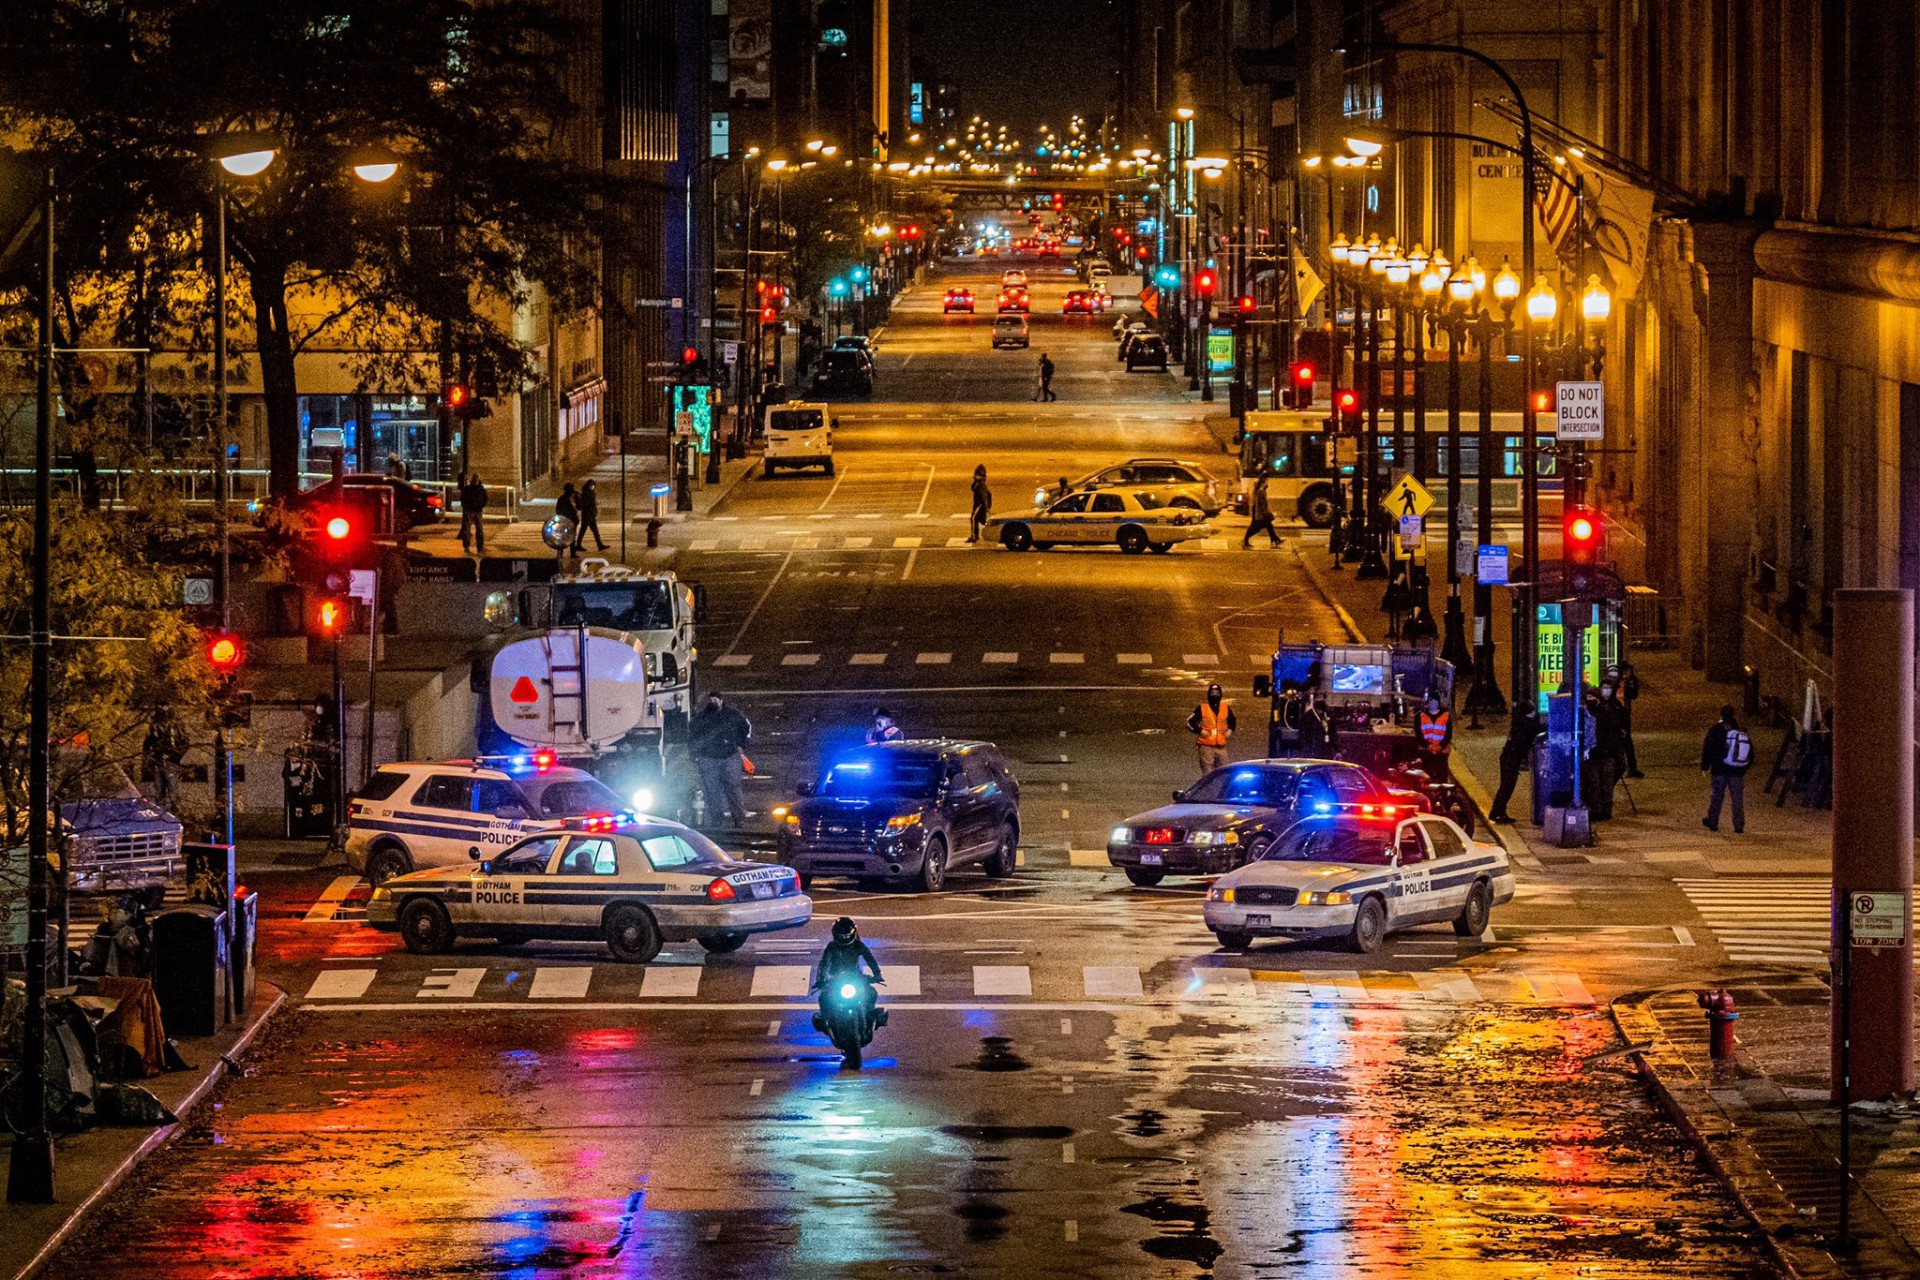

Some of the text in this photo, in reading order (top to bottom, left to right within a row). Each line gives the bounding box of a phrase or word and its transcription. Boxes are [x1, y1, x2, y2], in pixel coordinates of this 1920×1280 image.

[1561, 388, 1599, 401] DO NOT
[1561, 406, 1599, 419] BLOCK
[1561, 423, 1600, 433] INTERSECTION
[491, 821, 520, 830] GOTHAM
[481, 832, 518, 845] POLICE
[733, 870, 769, 883] GOTHAM
[1405, 881, 1429, 895] POLICE
[476, 892, 519, 904] POLICE
